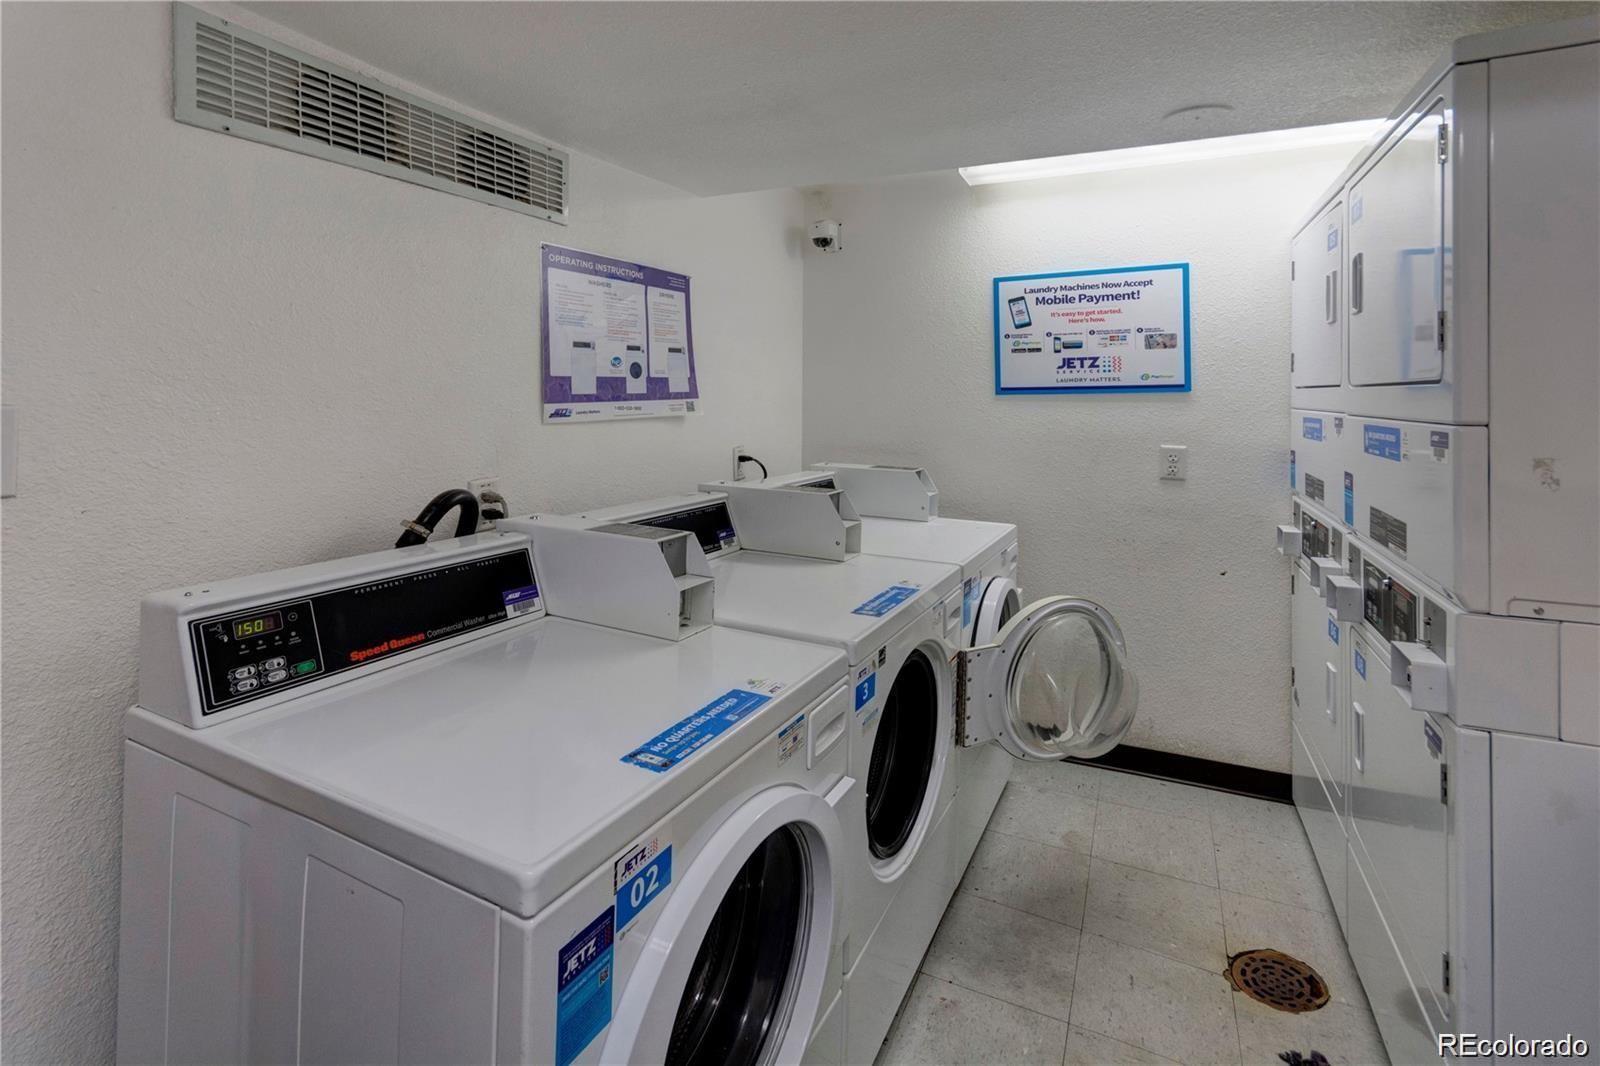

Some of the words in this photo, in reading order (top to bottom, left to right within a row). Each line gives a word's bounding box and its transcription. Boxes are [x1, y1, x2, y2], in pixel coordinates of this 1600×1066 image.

[548, 253, 594, 270] OPERATING
[595, 263, 644, 280] INSTRUCTIONS
[1024, 285, 1058, 295] Laundry
[1059, 283, 1100, 292] Machines
[1101, 281, 1122, 289] Now
[1122, 279, 1154, 289] Accept
[1035, 294, 1076, 306] Mobile
[1078, 290, 1141, 305] Payment!
[1050, 310, 1061, 318] It's
[1056, 356, 1100, 370] JETZ
[354, 579, 405, 595] PERMANENT
[413, 572, 438, 582] PRESS
[350, 641, 388, 662] Speed
[389, 632, 426, 649] Queen
[426, 621, 464, 639] Commercial
[464, 615, 486, 628] Washer
[862, 682, 869, 700] 3
[650, 742, 668, 753] NO
[665, 715, 711, 744] QUARTERS
[621, 846, 648, 878] JETZ
[630, 864, 660, 909] 02
[563, 936, 597, 980] JETZ
